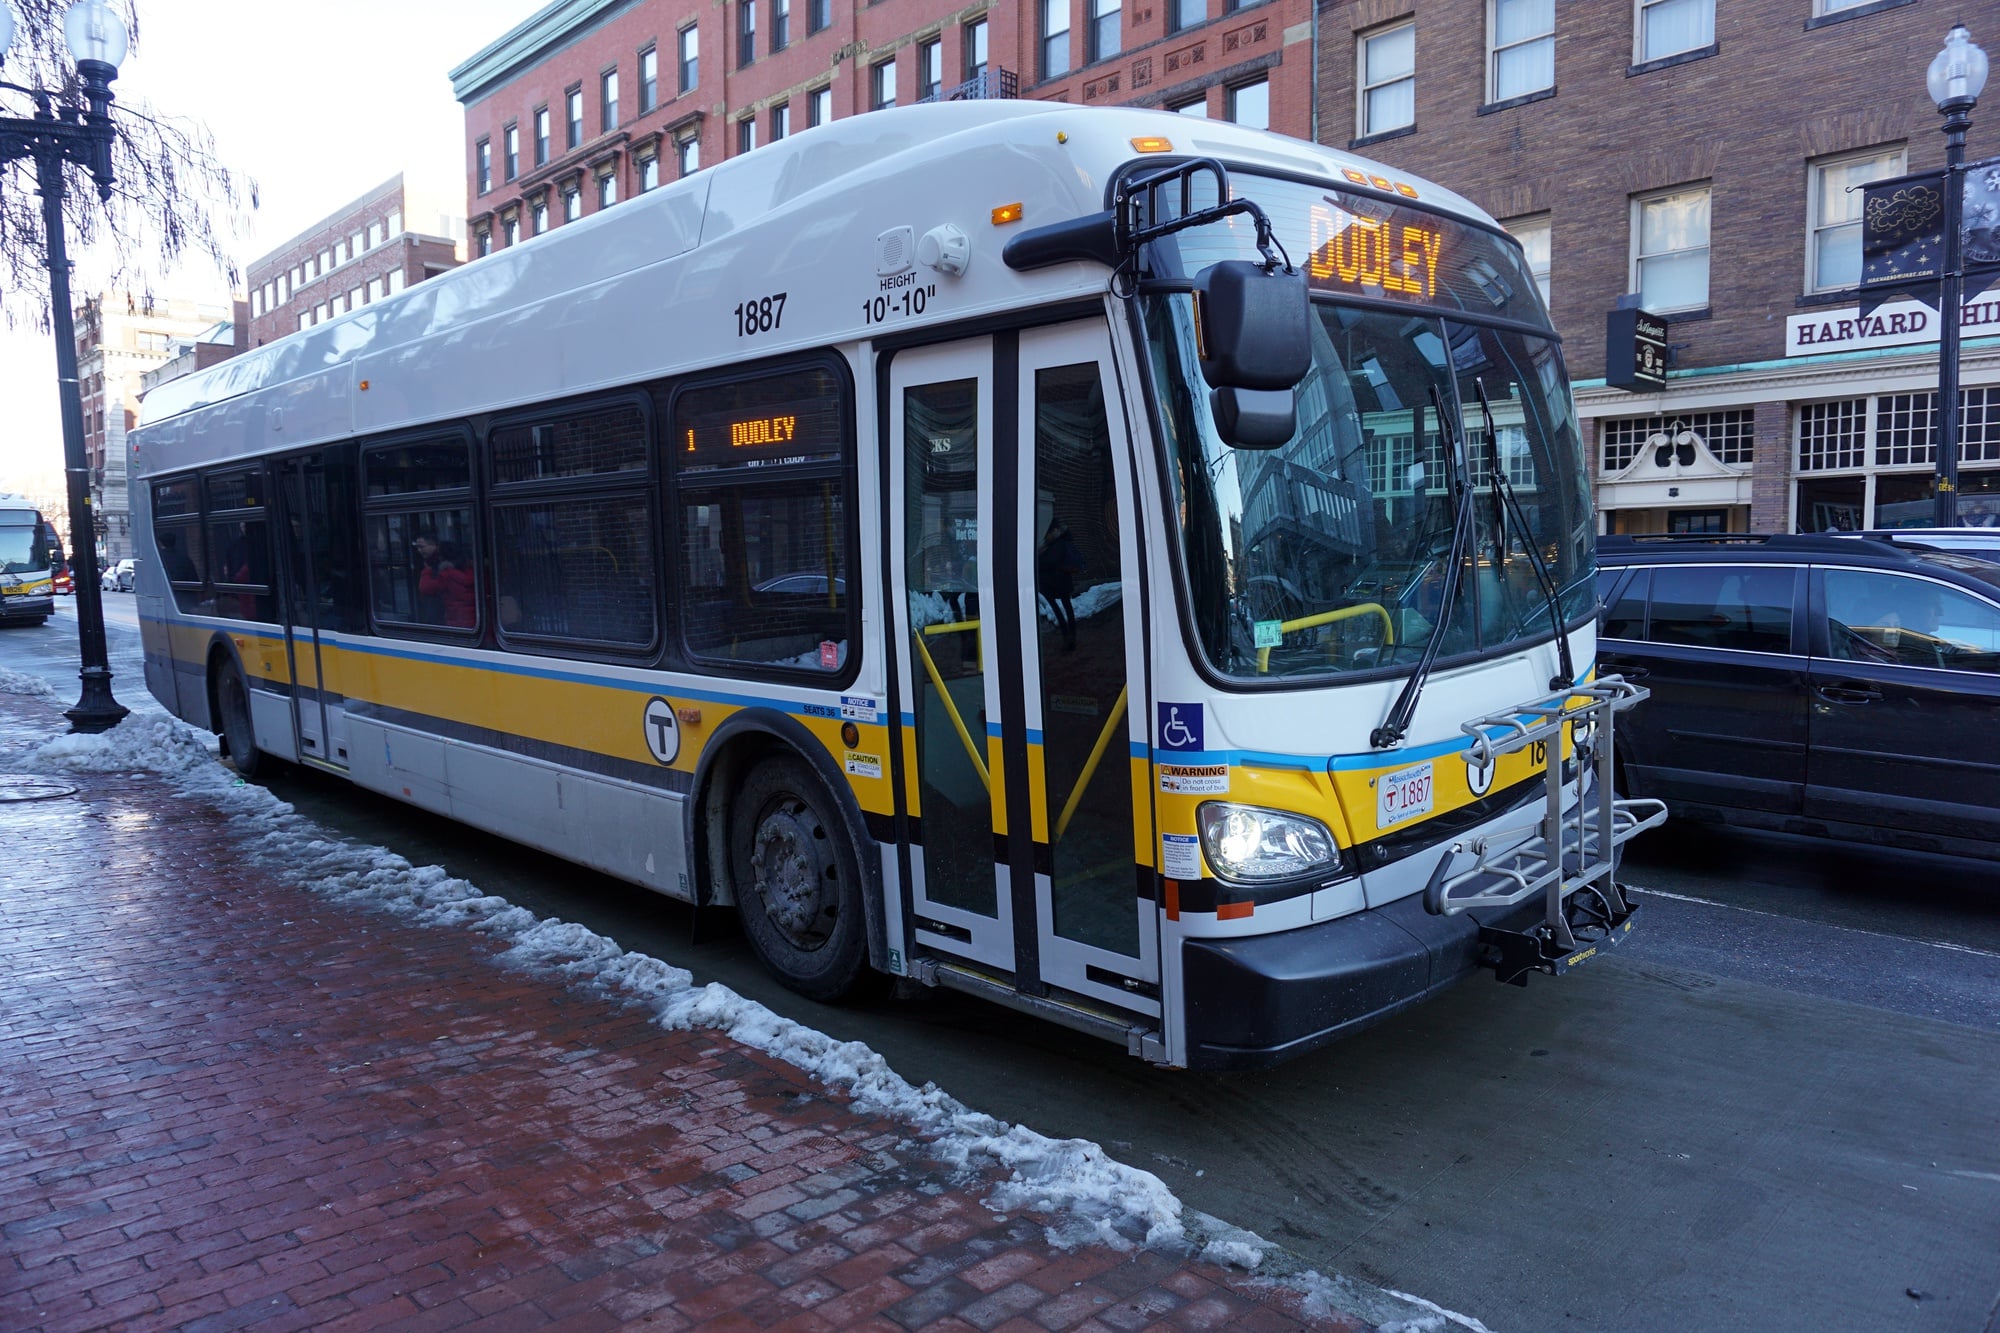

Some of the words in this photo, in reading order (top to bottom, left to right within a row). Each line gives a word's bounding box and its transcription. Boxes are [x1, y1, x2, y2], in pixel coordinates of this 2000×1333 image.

[1310, 204, 1442, 297] DUDLEY
[880, 272, 917, 291] HEIGHT
[734, 292, 787, 337] 1887
[863, 284, 936, 324] 10'-10"
[1797, 311, 1927, 345] HARVARD
[687, 429, 696, 451] 1
[732, 416, 796, 446] DUDLEY
[803, 704, 826, 715] SEATS
[826, 708, 836, 716] 36
[848, 697, 869, 707] NOTICE
[852, 753, 878, 765] CAUTION
[1171, 767, 1225, 776] WARNING
[1401, 775, 1431, 809] 1887
